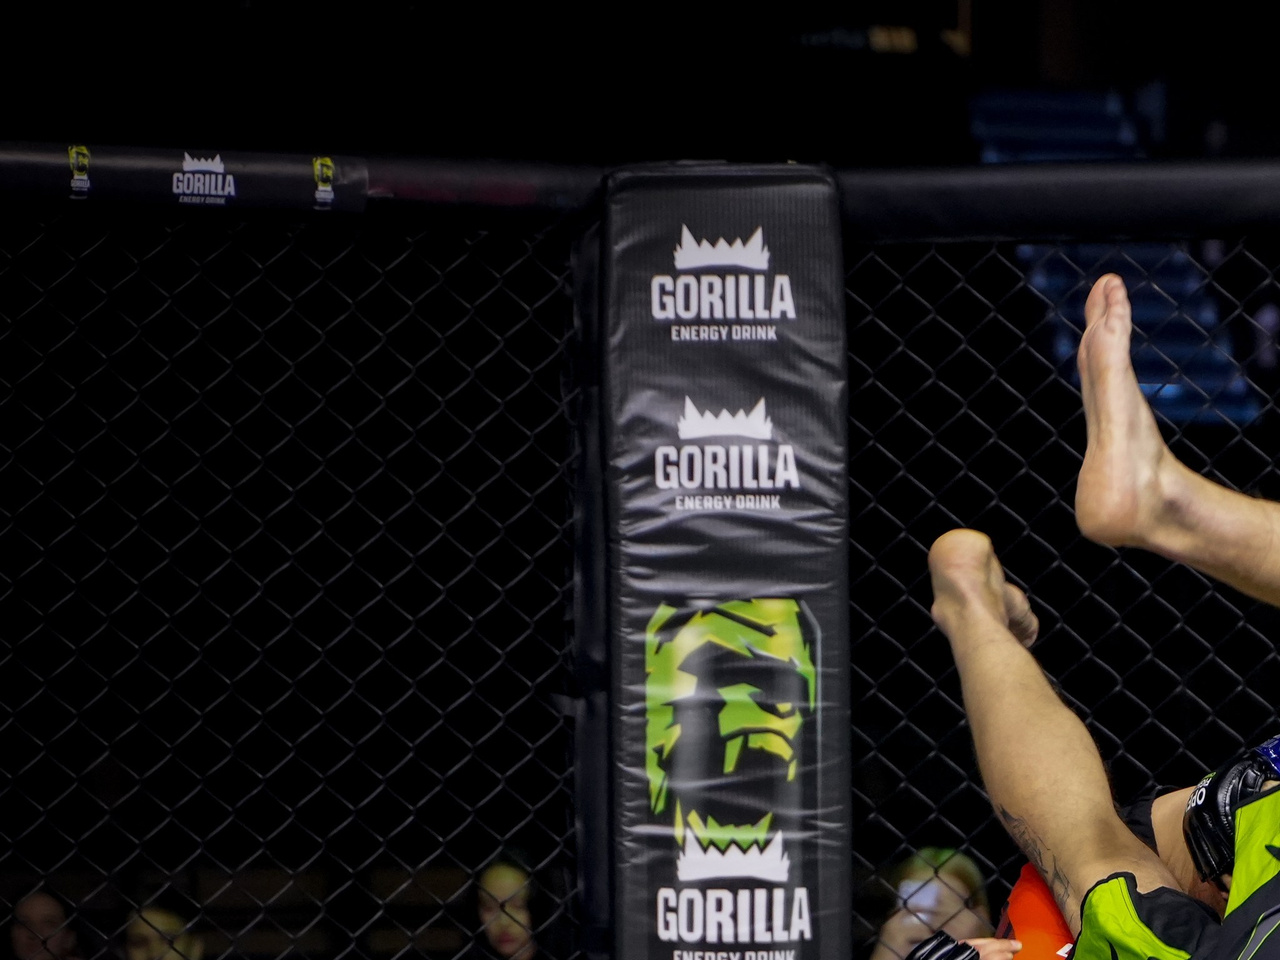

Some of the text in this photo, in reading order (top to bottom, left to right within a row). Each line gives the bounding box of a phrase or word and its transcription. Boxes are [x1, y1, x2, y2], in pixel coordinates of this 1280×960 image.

[172, 172, 236, 196] GORILLA
[651, 275, 796, 320] GORILLA
[671, 325, 777, 341] ENERGY DRINK
[655, 444, 799, 489] GORILLA
[675, 495, 780, 510] ENERGY DRINK
[657, 887, 812, 943] GORILLA
